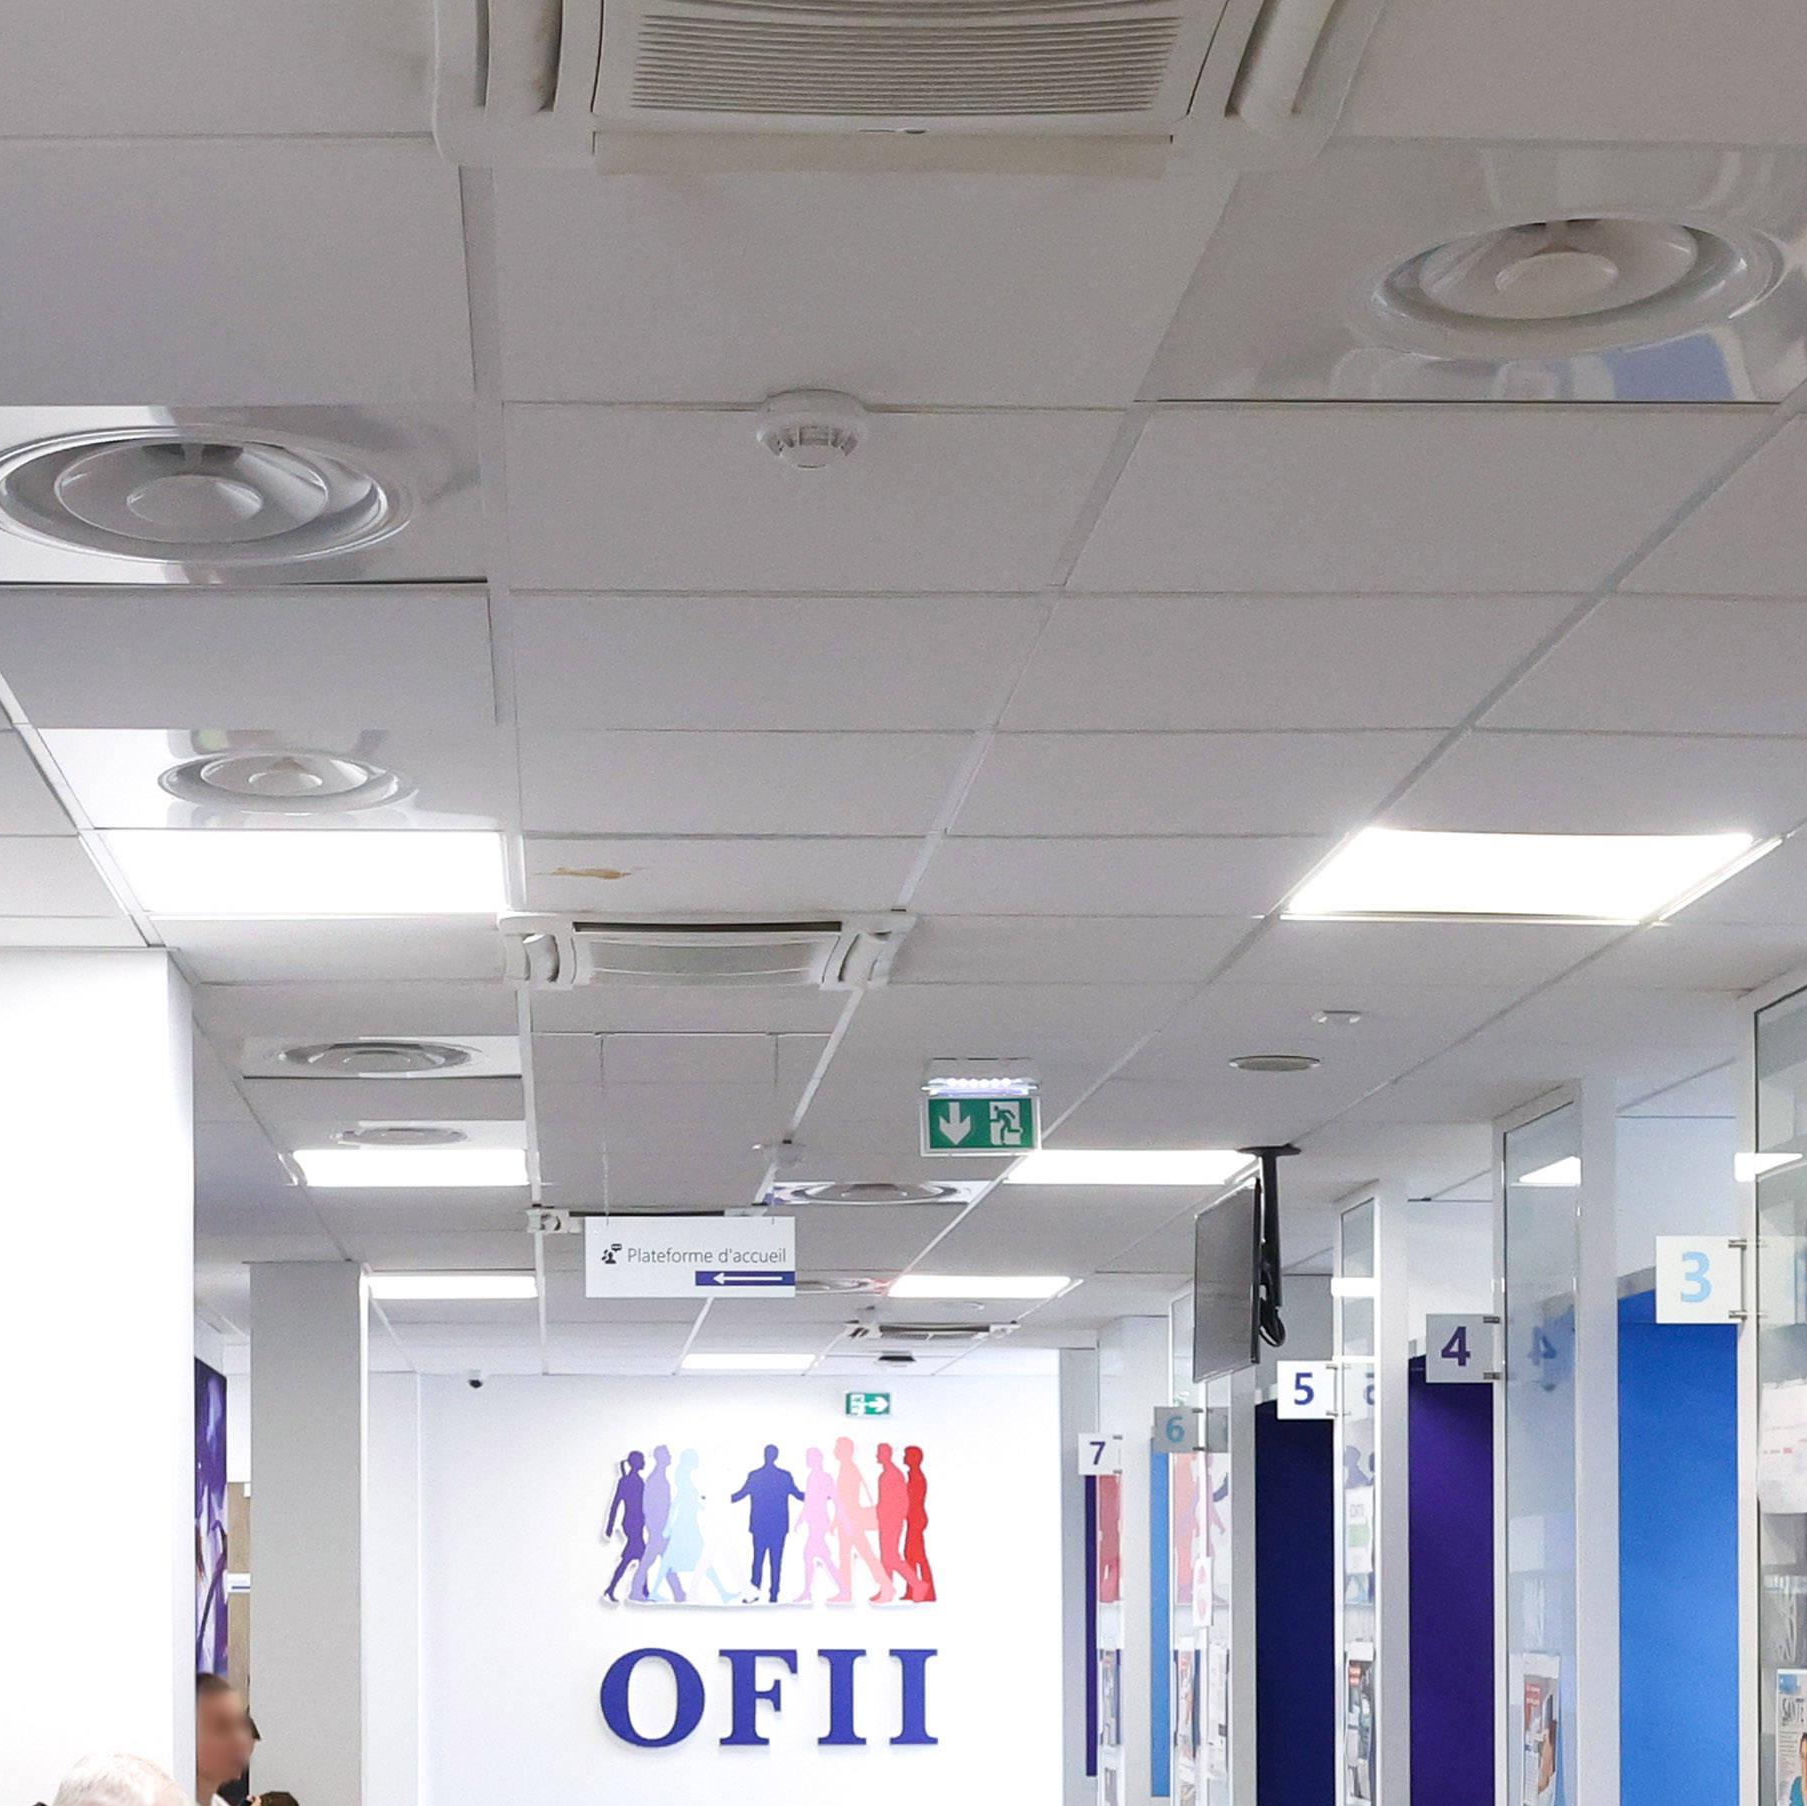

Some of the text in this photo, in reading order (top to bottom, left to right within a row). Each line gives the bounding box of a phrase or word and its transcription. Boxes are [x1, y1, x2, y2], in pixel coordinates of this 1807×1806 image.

[627, 1248, 786, 1264] Plateforme d'accueil
[1679, 1251, 1713, 1303] 3
[1441, 1326, 1471, 1367] 4
[1294, 1372, 1315, 1405] 5
[1164, 1416, 1186, 1443] 6
[1089, 1441, 1106, 1465] 7
[600, 1648, 938, 1748] OFII
